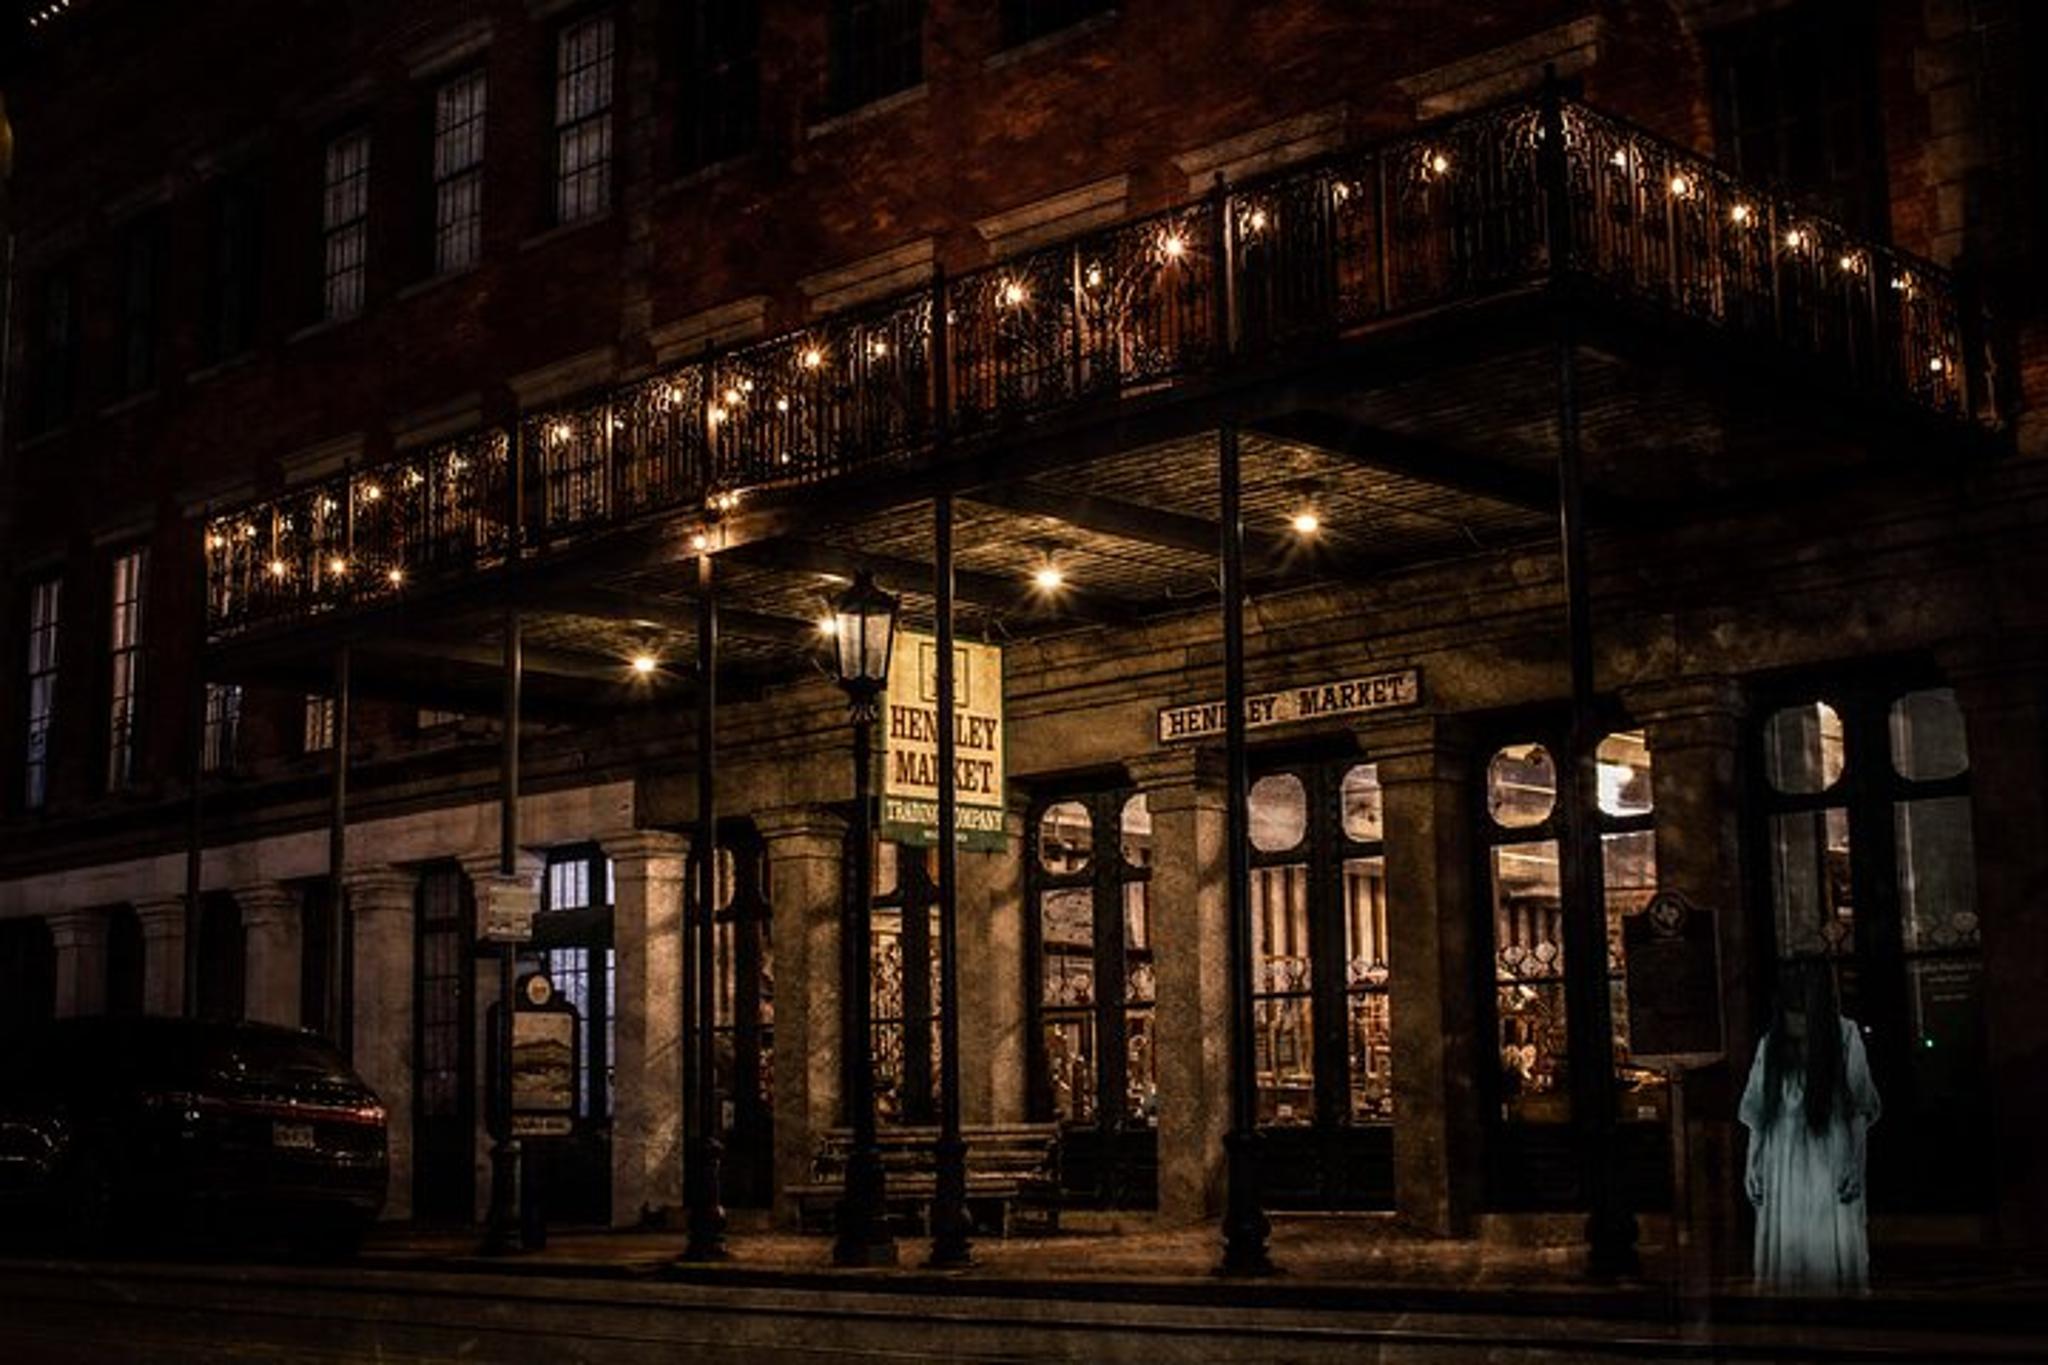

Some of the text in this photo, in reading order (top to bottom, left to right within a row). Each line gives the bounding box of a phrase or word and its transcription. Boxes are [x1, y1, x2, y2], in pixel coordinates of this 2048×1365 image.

[890, 704, 998, 751] HENLEY
[1169, 676, 1403, 735] HENEY MARKET
[896, 750, 993, 793] MAKET
[953, 806, 1002, 831] OMPANY
